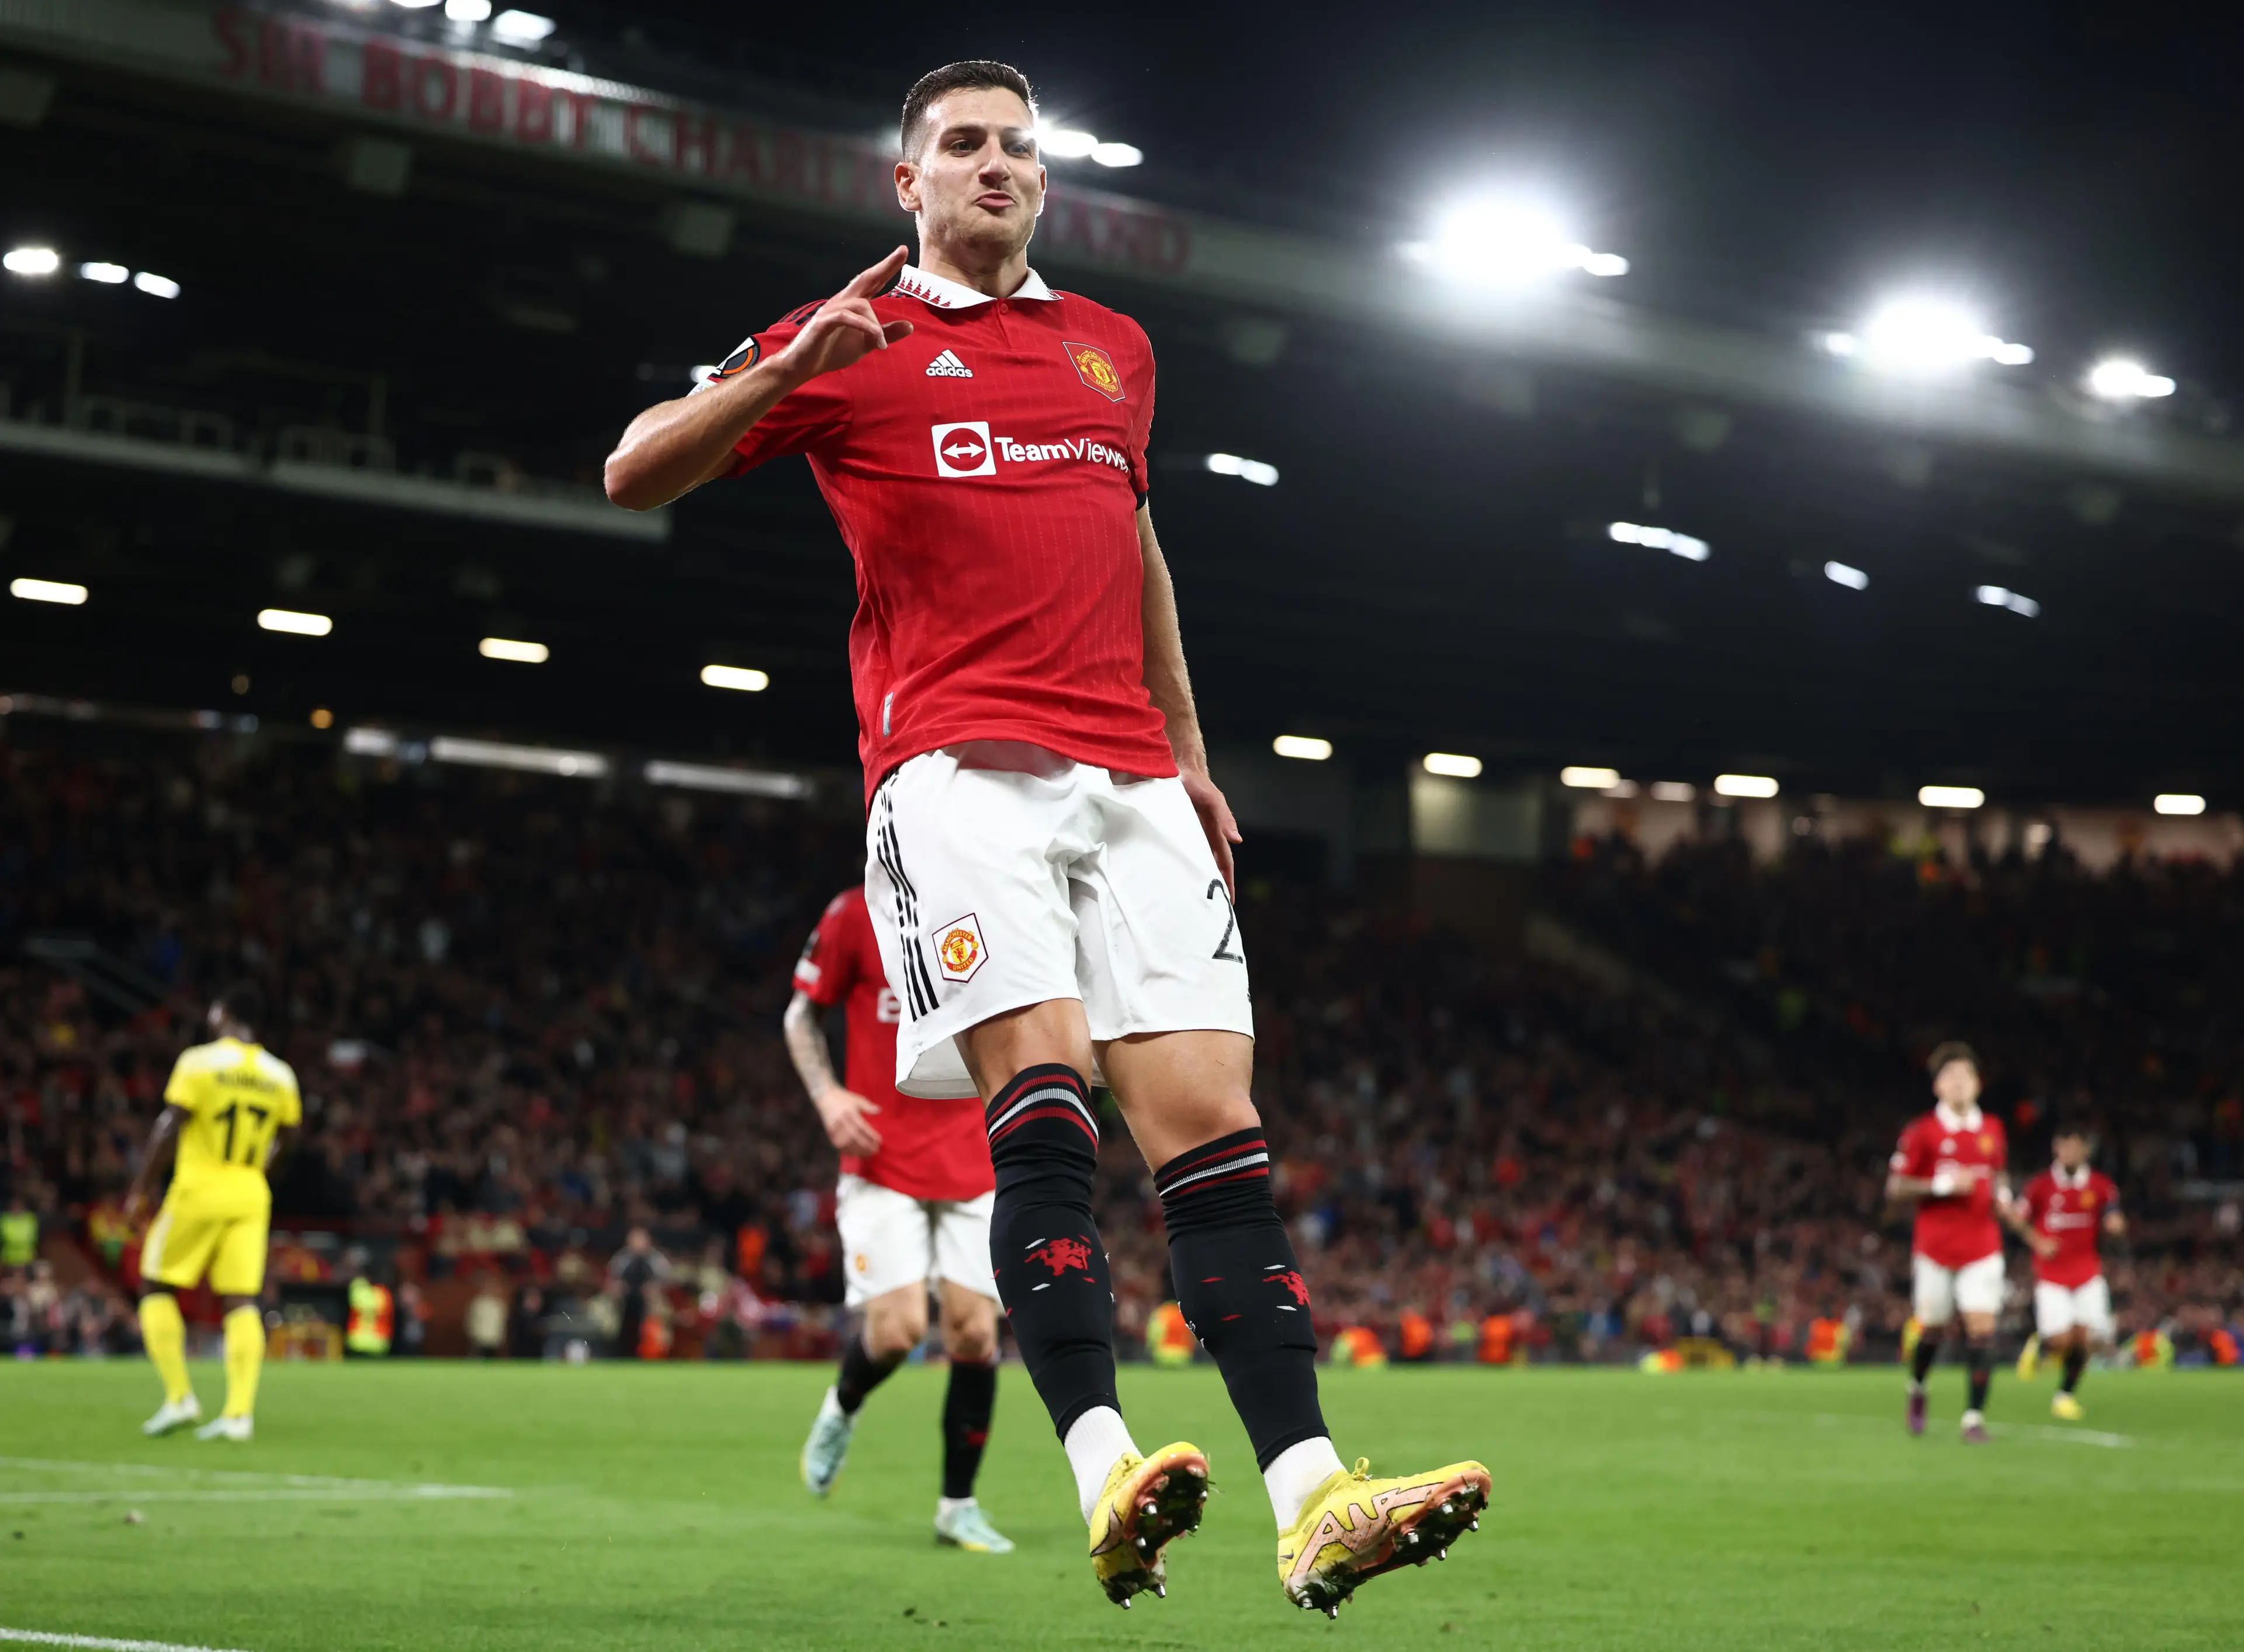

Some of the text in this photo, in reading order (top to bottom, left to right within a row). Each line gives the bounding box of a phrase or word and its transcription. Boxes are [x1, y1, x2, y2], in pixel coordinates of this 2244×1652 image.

[215, 5, 326, 95] SIR
[926, 365, 974, 378] adidas
[943, 930, 972, 952] MANCHESTER
[953, 957, 974, 971] UNITED
[213, 1100, 269, 1166] 17
